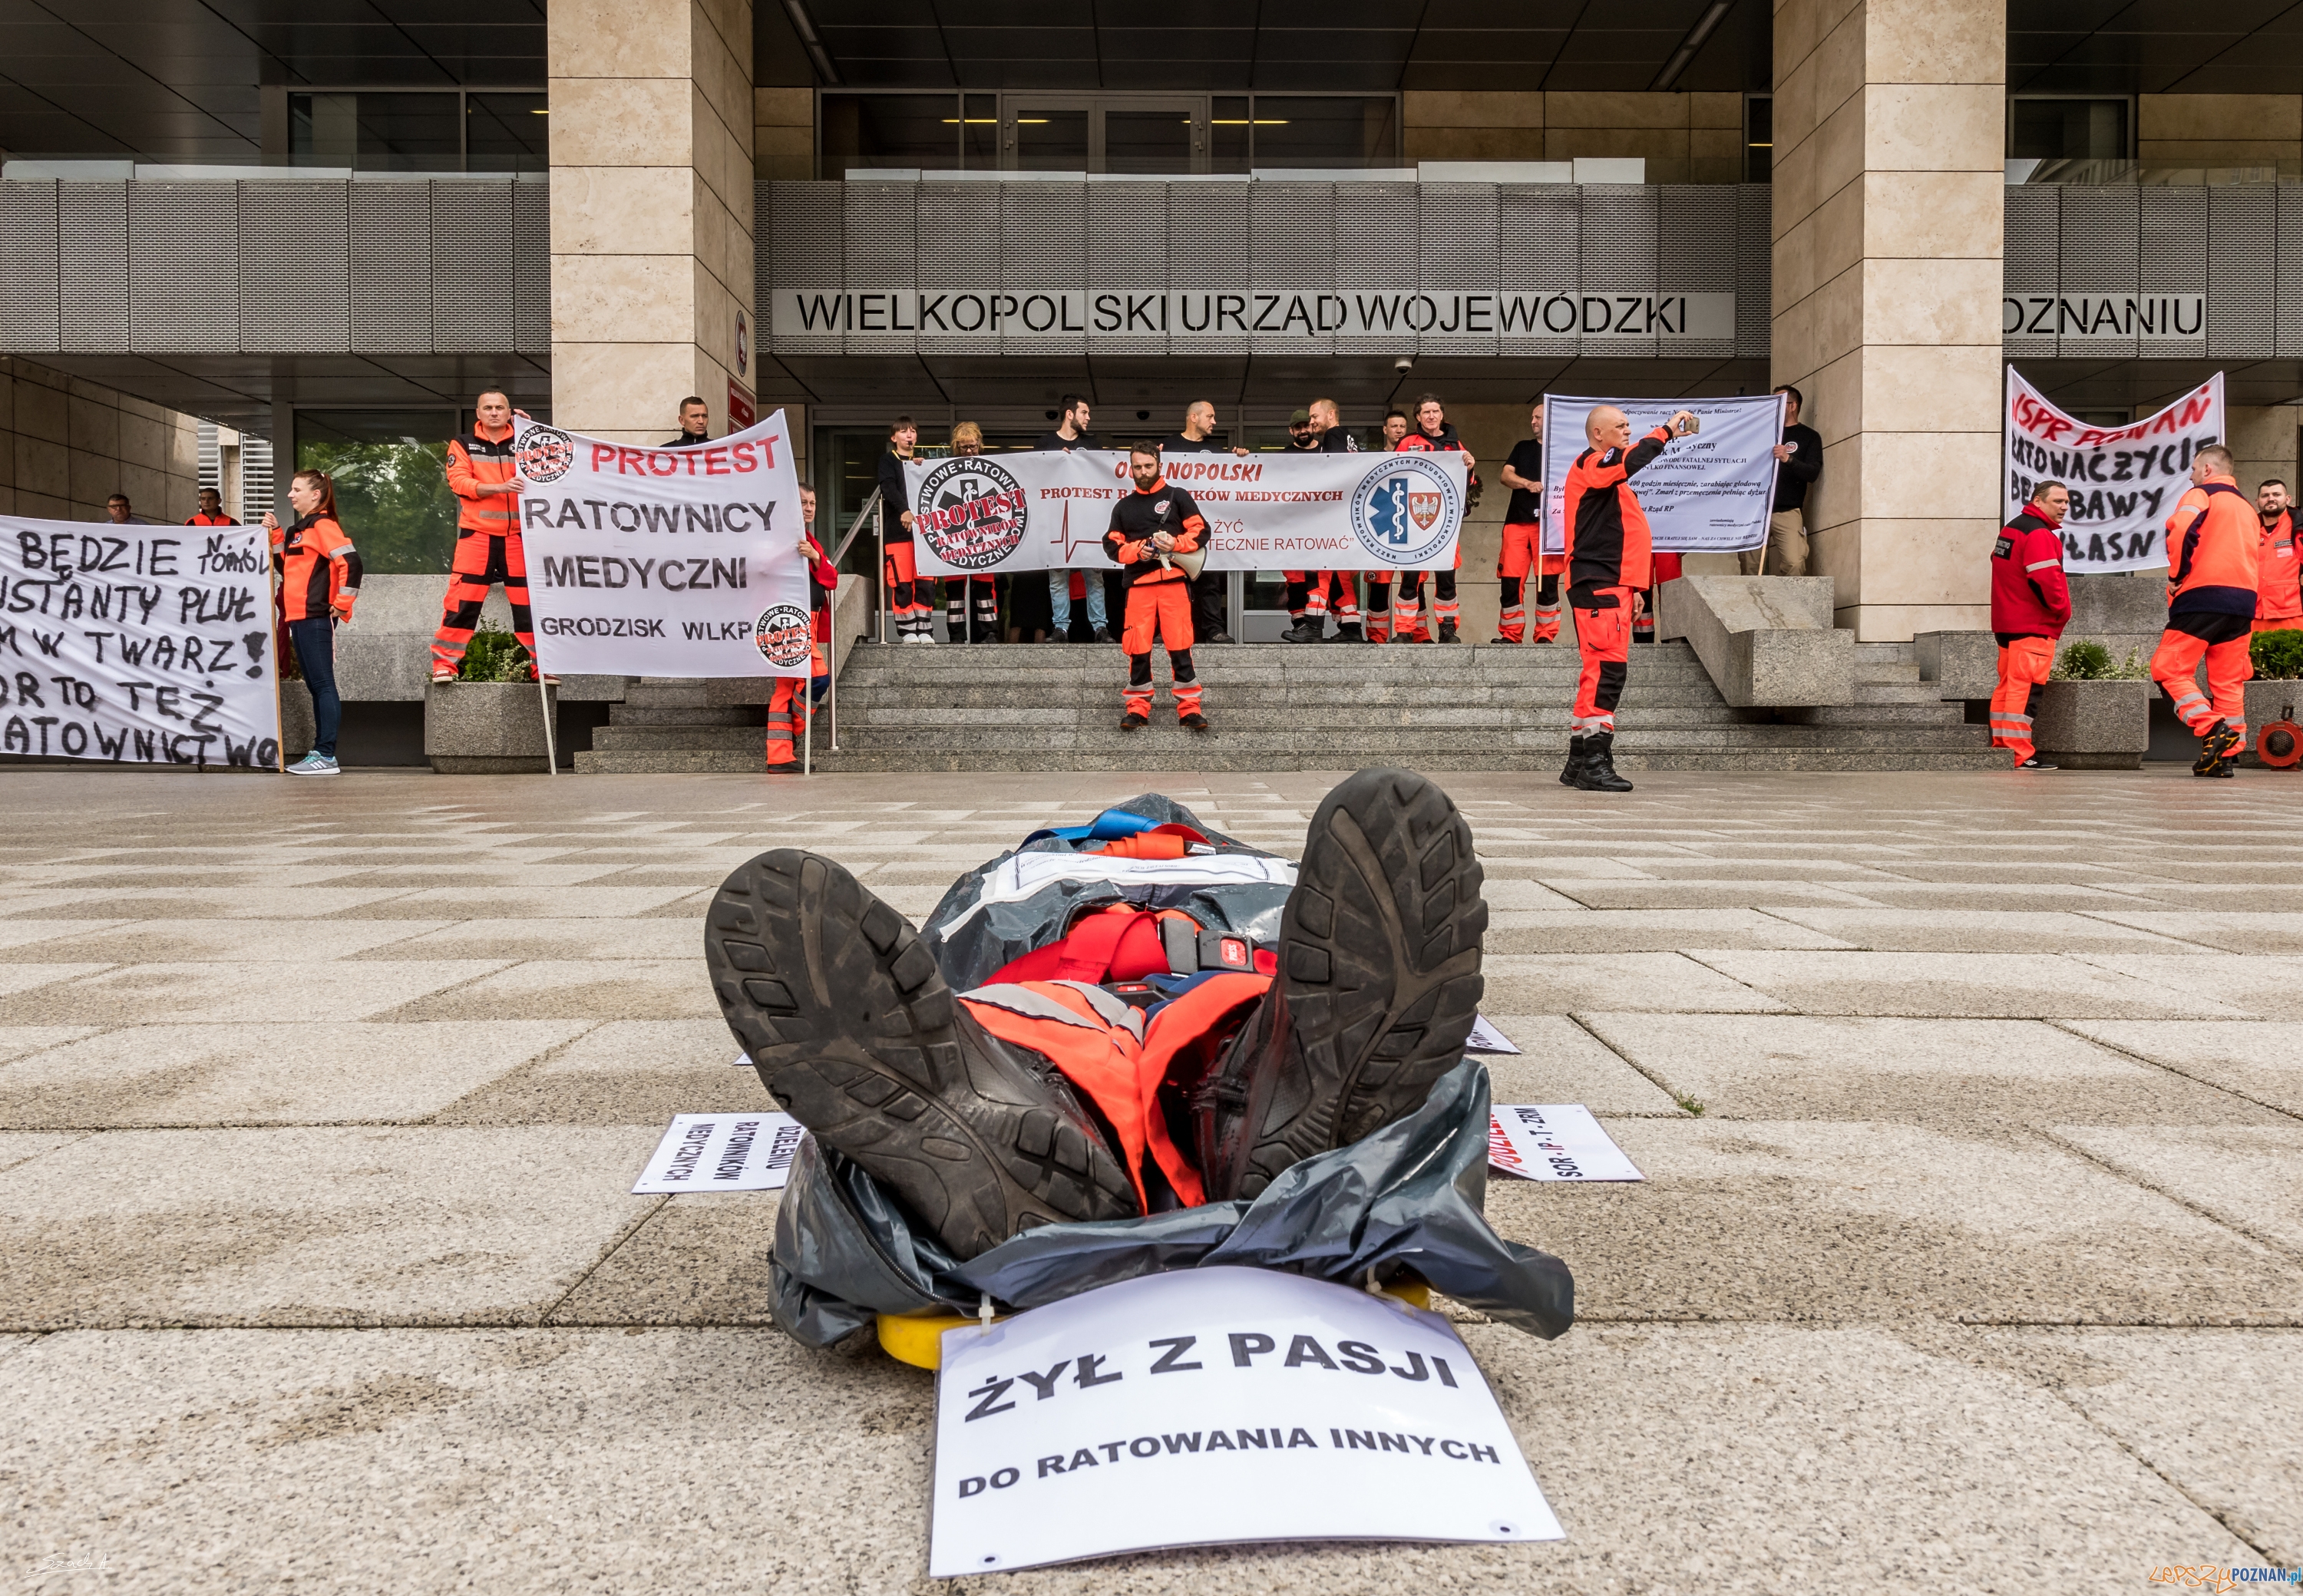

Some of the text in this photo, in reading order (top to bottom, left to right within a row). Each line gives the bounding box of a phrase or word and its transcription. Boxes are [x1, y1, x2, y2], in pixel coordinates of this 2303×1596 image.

[796, 292, 2202, 337] WIELKOPOLSKI URZĄD WOJEWÓDZKI OZNANIU
[592, 435, 780, 477] PROTEST
[1362, 459, 1411, 491] MEDYCZNYCH
[1040, 486, 1112, 500] PROTEST
[1234, 490, 1343, 502] MEDYCZNYCH
[1413, 460, 1454, 505] POŁUDNIOWEJ
[1722, 488, 1746, 497] pełniąc
[524, 498, 777, 534] RATOWNICY
[916, 487, 1027, 535] PROTEST
[1214, 519, 1244, 534] ŻYĆ
[1355, 494, 1374, 548] RATOWNIKÓW
[937, 518, 1019, 547] RATOWNIKÓW
[940, 534, 1020, 562] MEDYCZNYCH
[1208, 538, 1270, 551] TECZNIE
[1414, 509, 1455, 560] WIELKOPOLSKI
[17, 530, 181, 580] BĘDZIE
[544, 555, 748, 592] MEDYCZNI
[178, 586, 256, 624] PLUŁ
[540, 616, 753, 641] GRODZISK WLKP
[32, 628, 65, 658] W
[84, 631, 268, 679] TWARZ!
[50, 676, 95, 708] TO
[116, 679, 224, 733] TEŻ
[0, 714, 279, 768] ATOWNICTWO
[1513, 1108, 1546, 1124] ZRM
[662, 1123, 716, 1181] MEDYCZNYCH
[712, 1121, 760, 1180] RATOWNIKÓW
[1537, 1142, 1565, 1151] IP
[1548, 1157, 1584, 1178] SOR
[963, 1333, 1460, 1423] ŻYŁ Z PASJI
[958, 1427, 1501, 1499] DO RATOWANIA INNYCH
